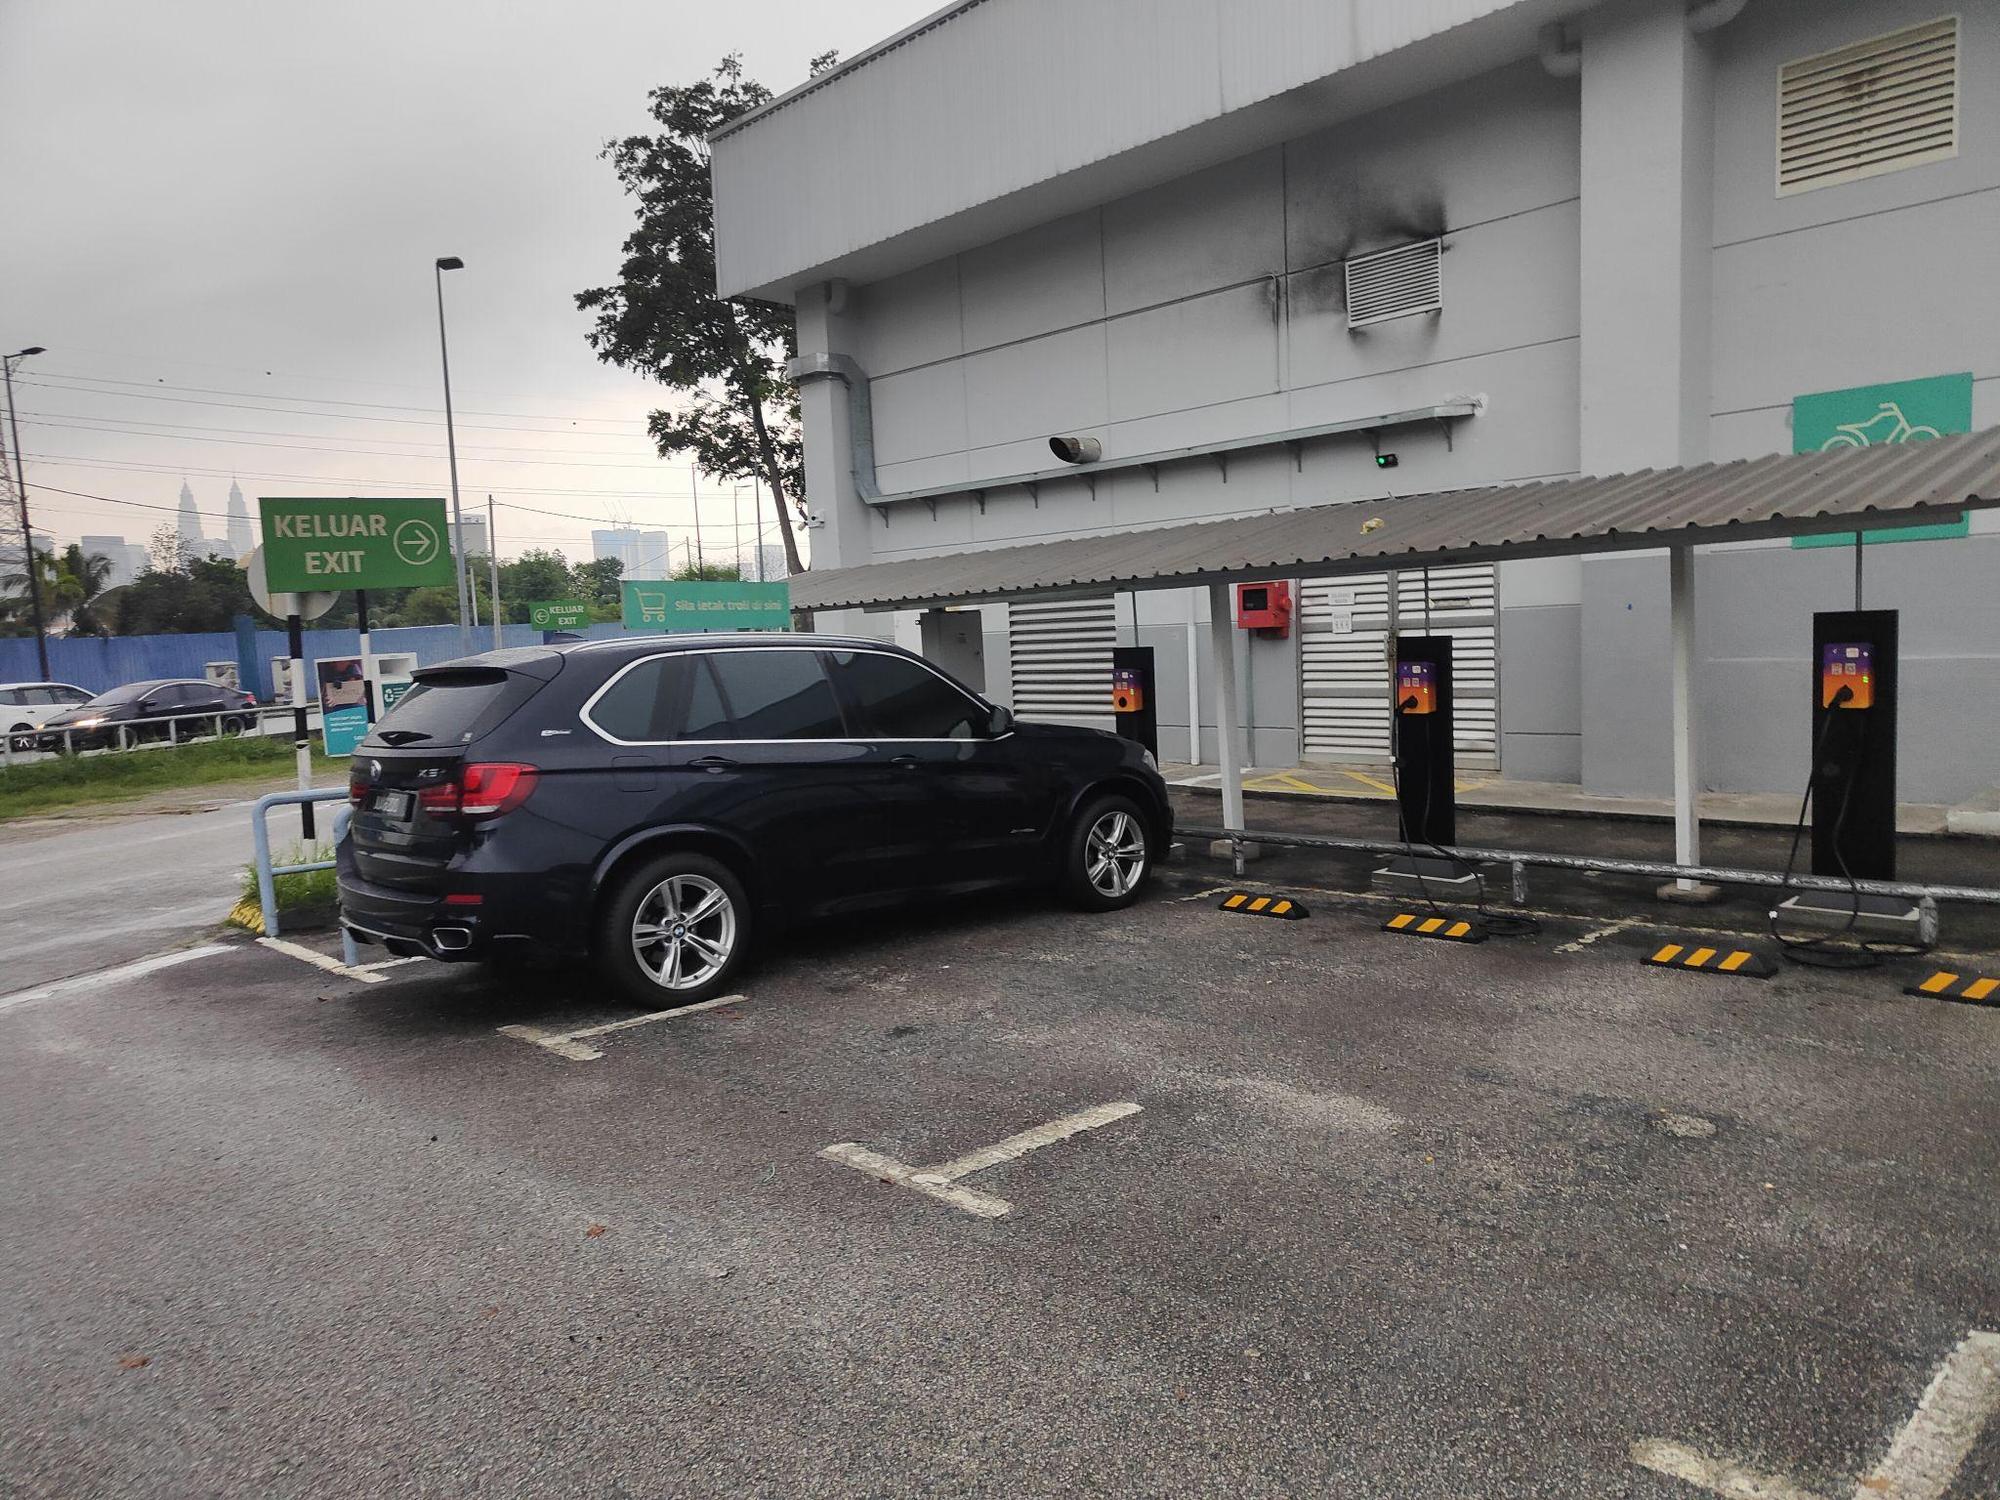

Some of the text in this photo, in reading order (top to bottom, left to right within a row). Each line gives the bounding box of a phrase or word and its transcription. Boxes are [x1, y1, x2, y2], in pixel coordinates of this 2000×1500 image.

[274, 514, 388, 538] KELUAR
[304, 551, 365, 574] EXIT
[549, 605, 584, 614] KELUAR
[558, 617, 577, 625] EXIT
